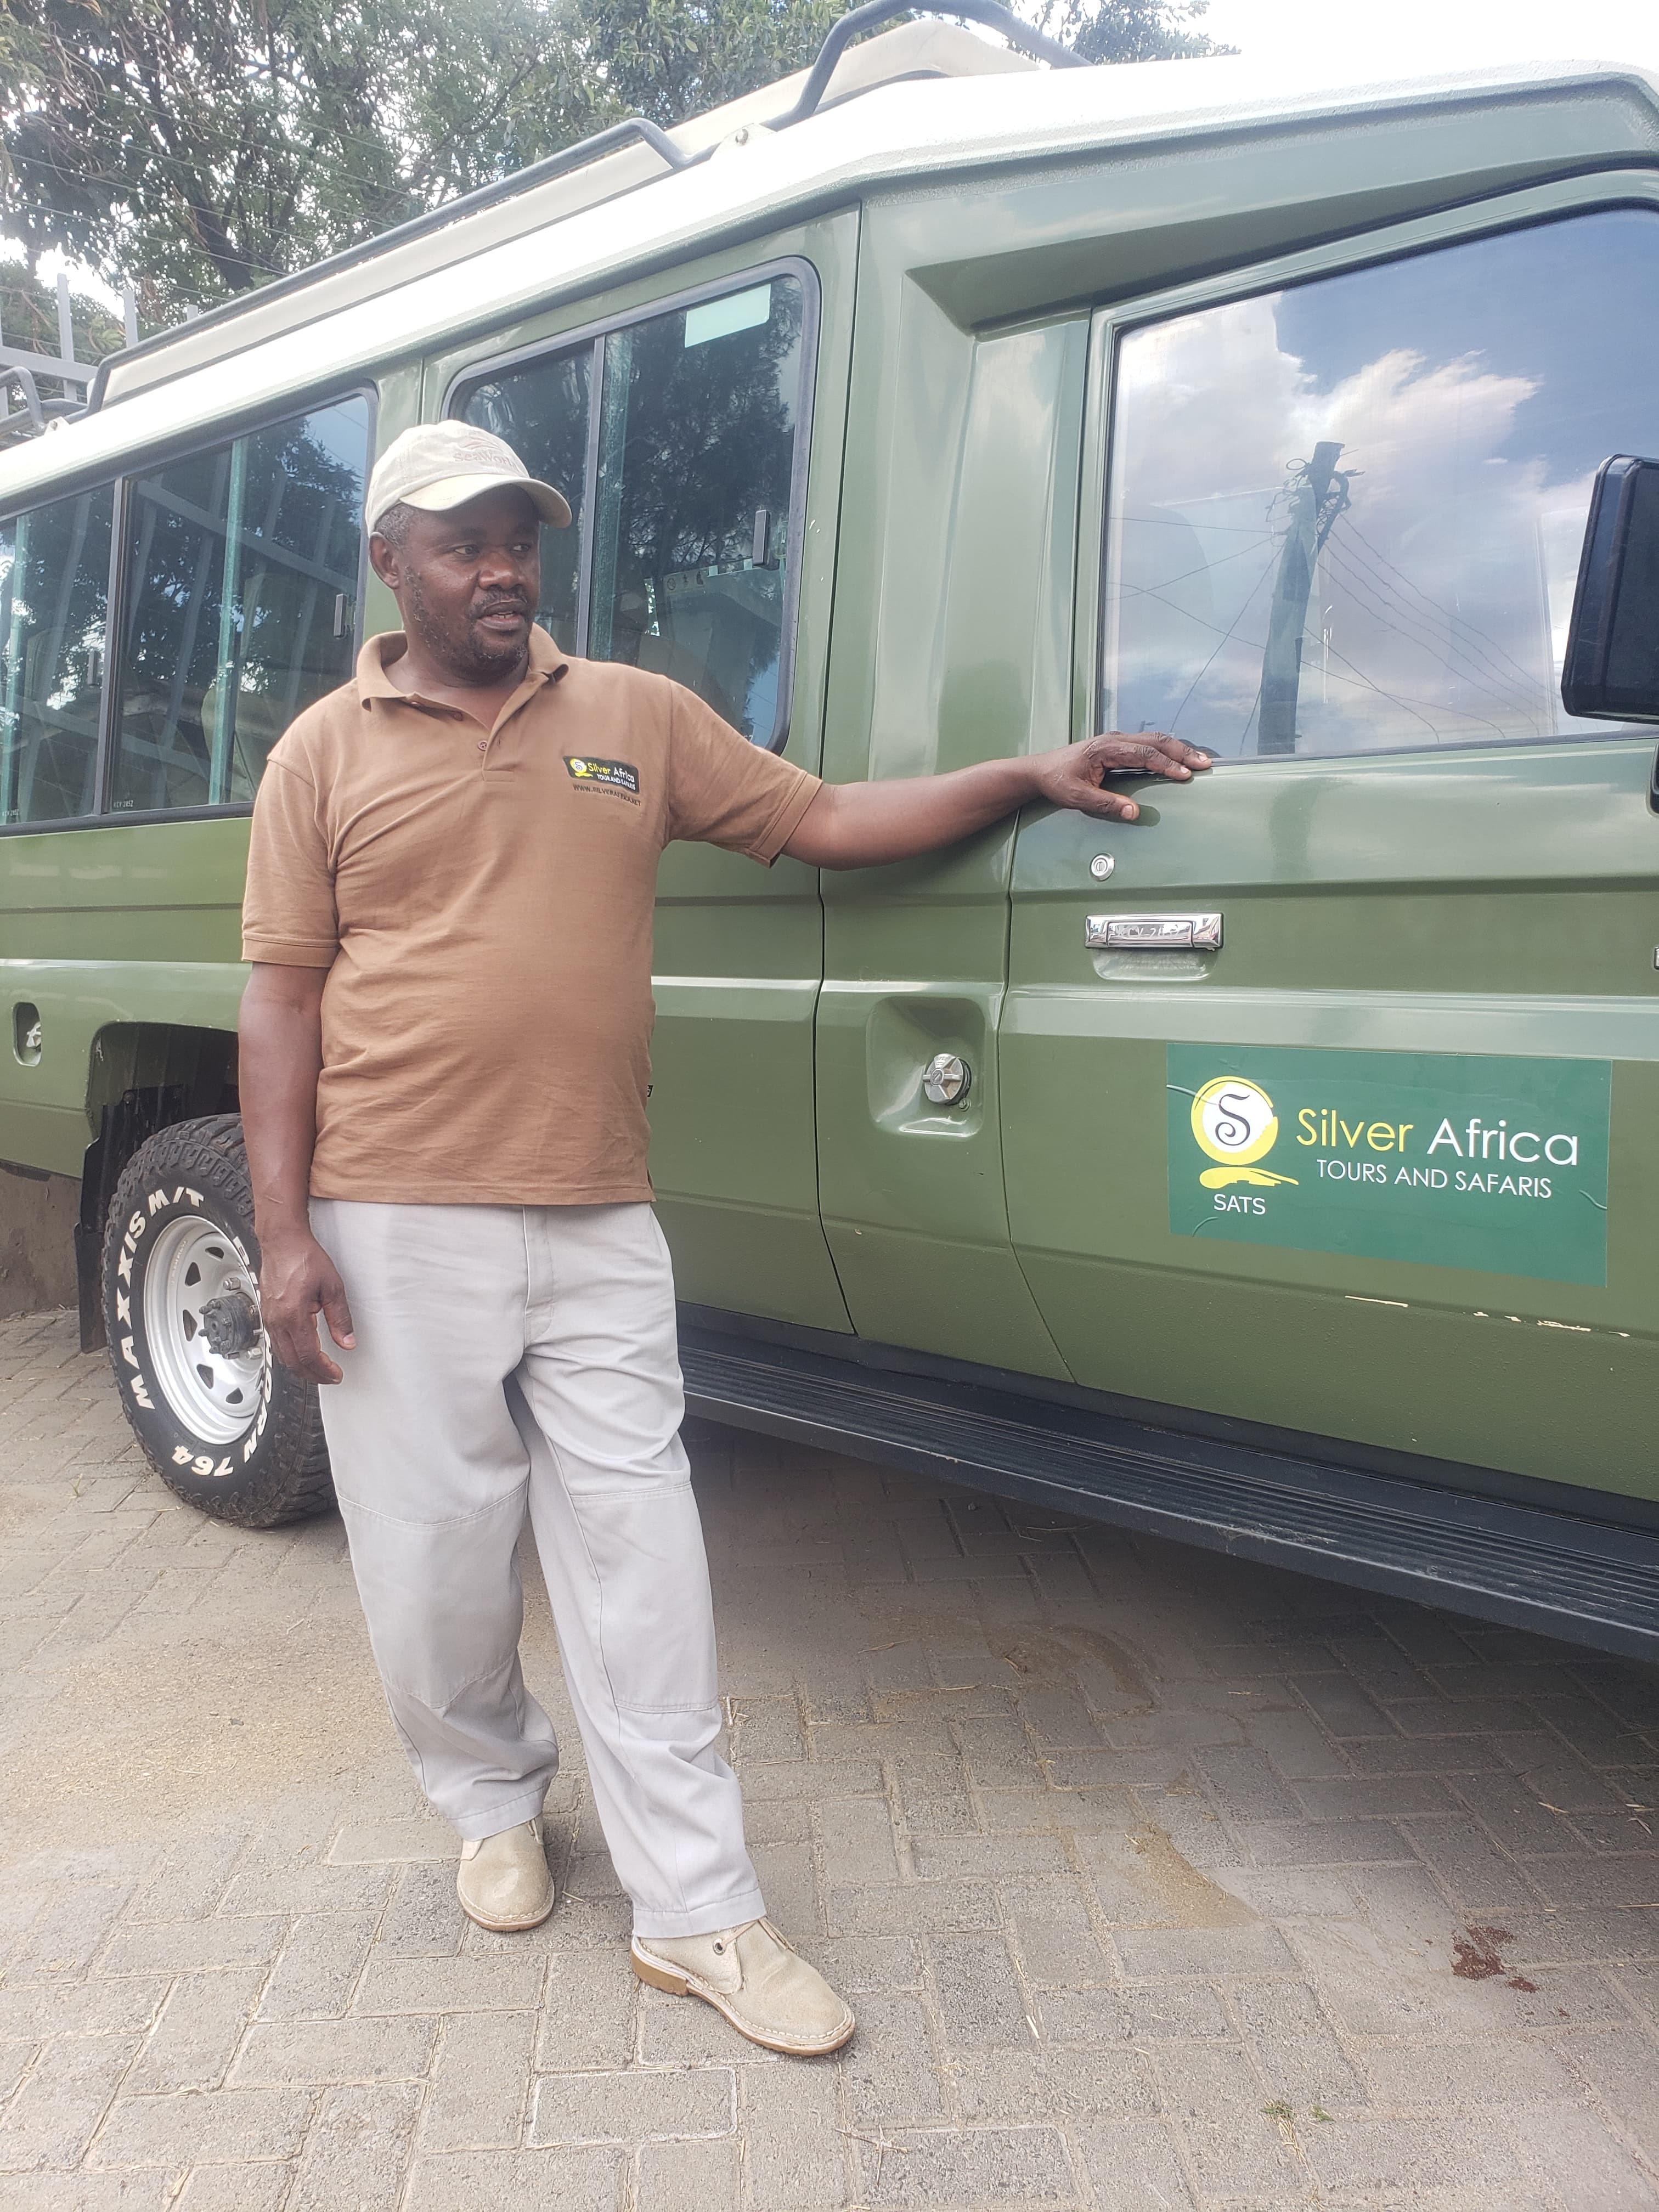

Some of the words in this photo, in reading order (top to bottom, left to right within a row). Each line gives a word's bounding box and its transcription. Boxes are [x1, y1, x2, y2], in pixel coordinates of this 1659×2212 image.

[588, 763, 611, 775] Silver
[613, 767, 635, 783] Africa
[1296, 1108, 1414, 1153] Silver
[1426, 1118, 1578, 1166] Africa
[1317, 1158, 1387, 1184] TOURS
[1394, 1166, 1448, 1189] AND
[1455, 1170, 1553, 1199] SAFARIS
[1213, 1193, 1266, 1216] SATS
[116, 1210, 155, 1409] MAXXIS
[148, 1186, 204, 1217] M/T
[171, 1445, 234, 1477] 764
